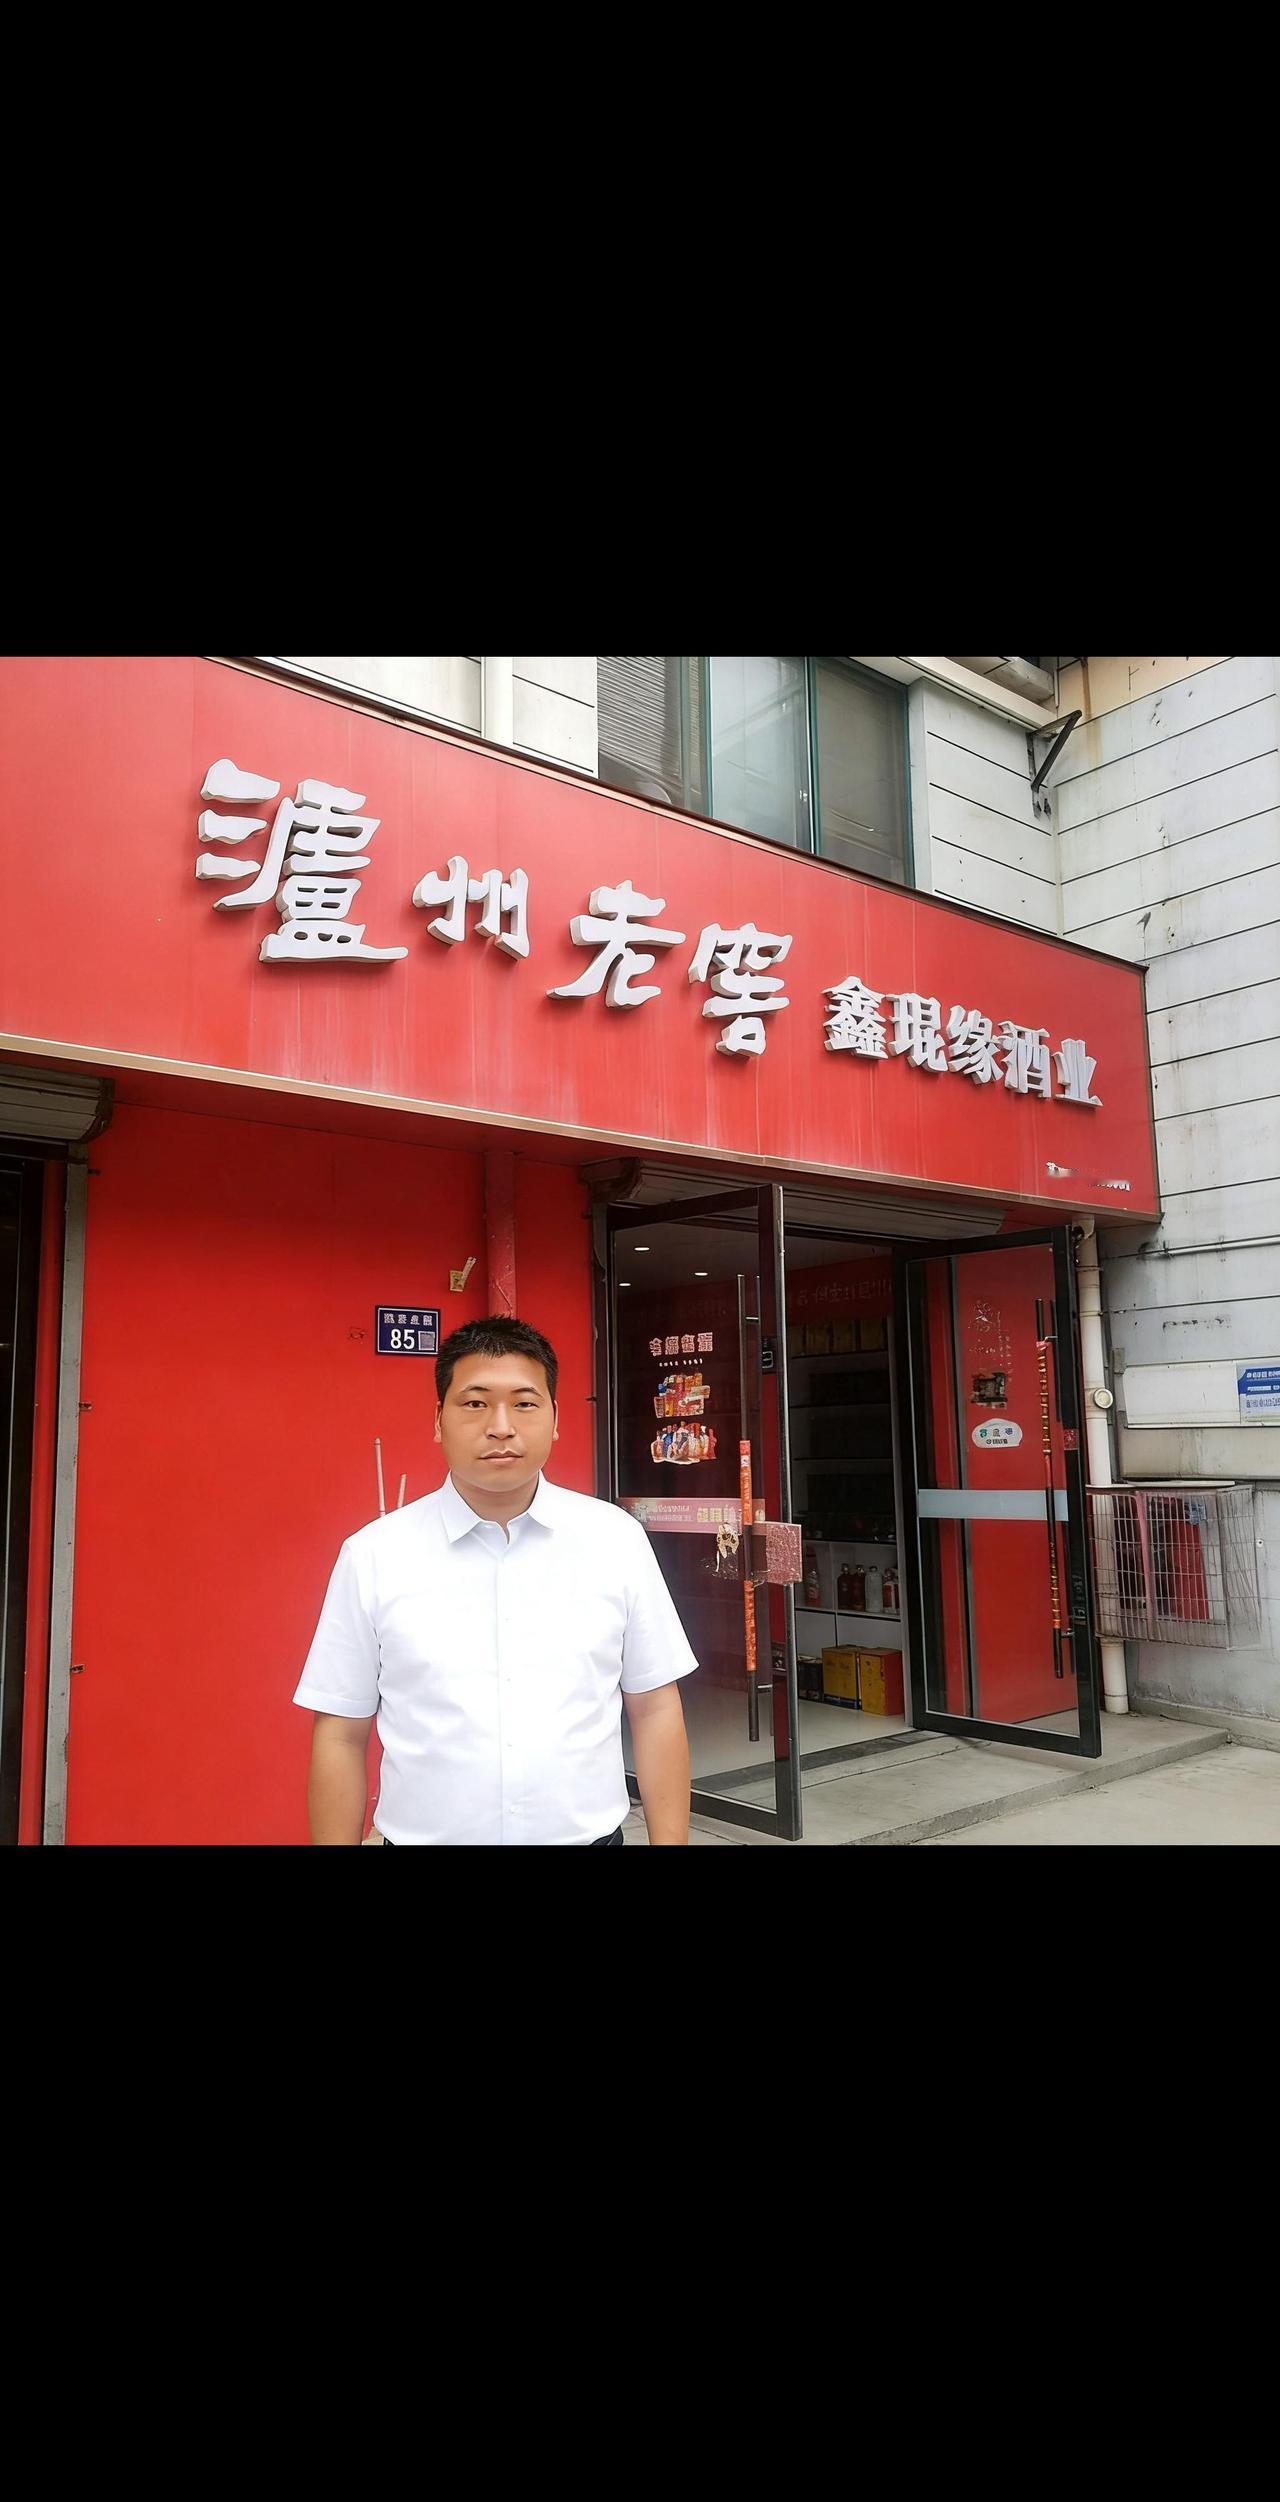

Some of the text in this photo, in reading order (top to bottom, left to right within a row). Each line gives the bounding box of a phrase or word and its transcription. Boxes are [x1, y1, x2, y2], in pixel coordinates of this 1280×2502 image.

[822, 976, 1103, 1107] 鑫琨缘酒业
[390, 1328, 415, 1350] 85
